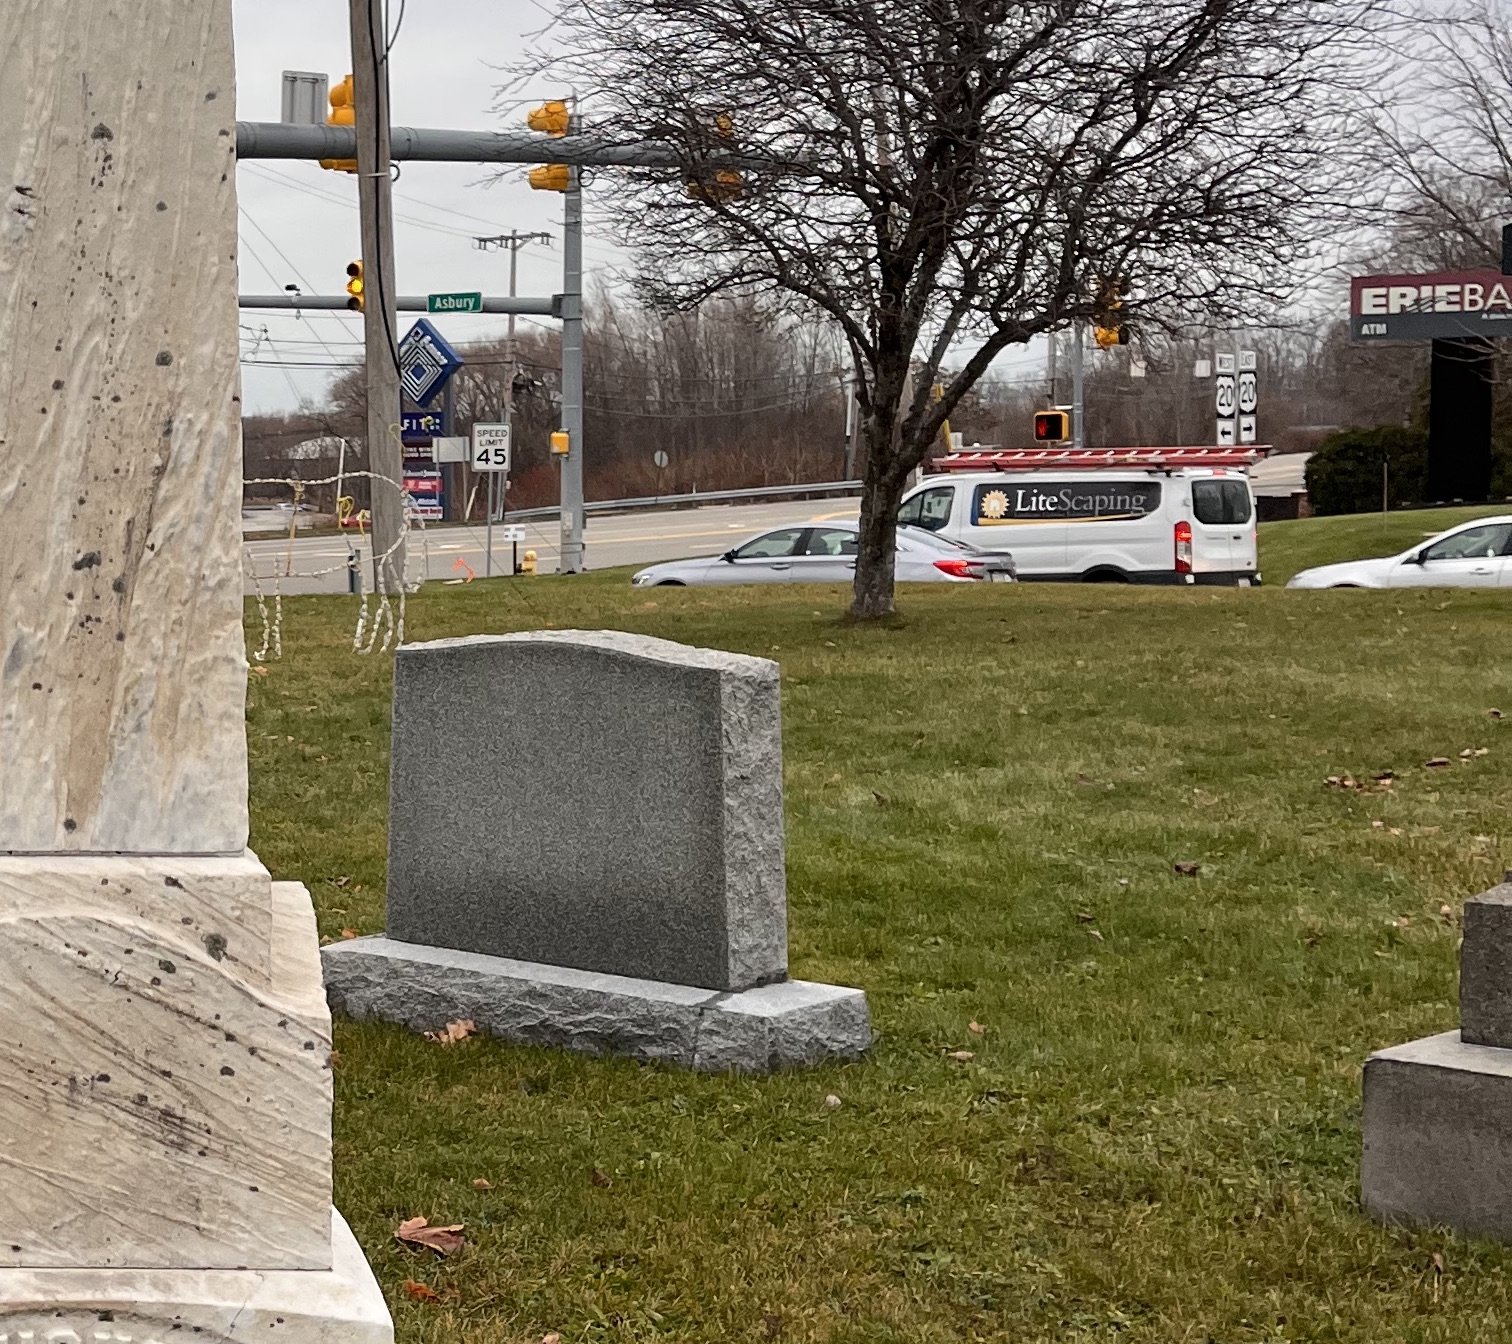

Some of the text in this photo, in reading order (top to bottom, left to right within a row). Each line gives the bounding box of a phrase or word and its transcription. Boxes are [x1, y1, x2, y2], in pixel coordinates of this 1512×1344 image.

[434, 296, 475, 312] Asbury
[1361, 323, 1388, 335] ATM
[1218, 384, 1233, 407] 20
[1241, 381, 1255, 403] 20
[477, 429, 508, 437] SPEED
[476, 448, 506, 465] 45
[1015, 487, 1148, 518] LiteScaping
